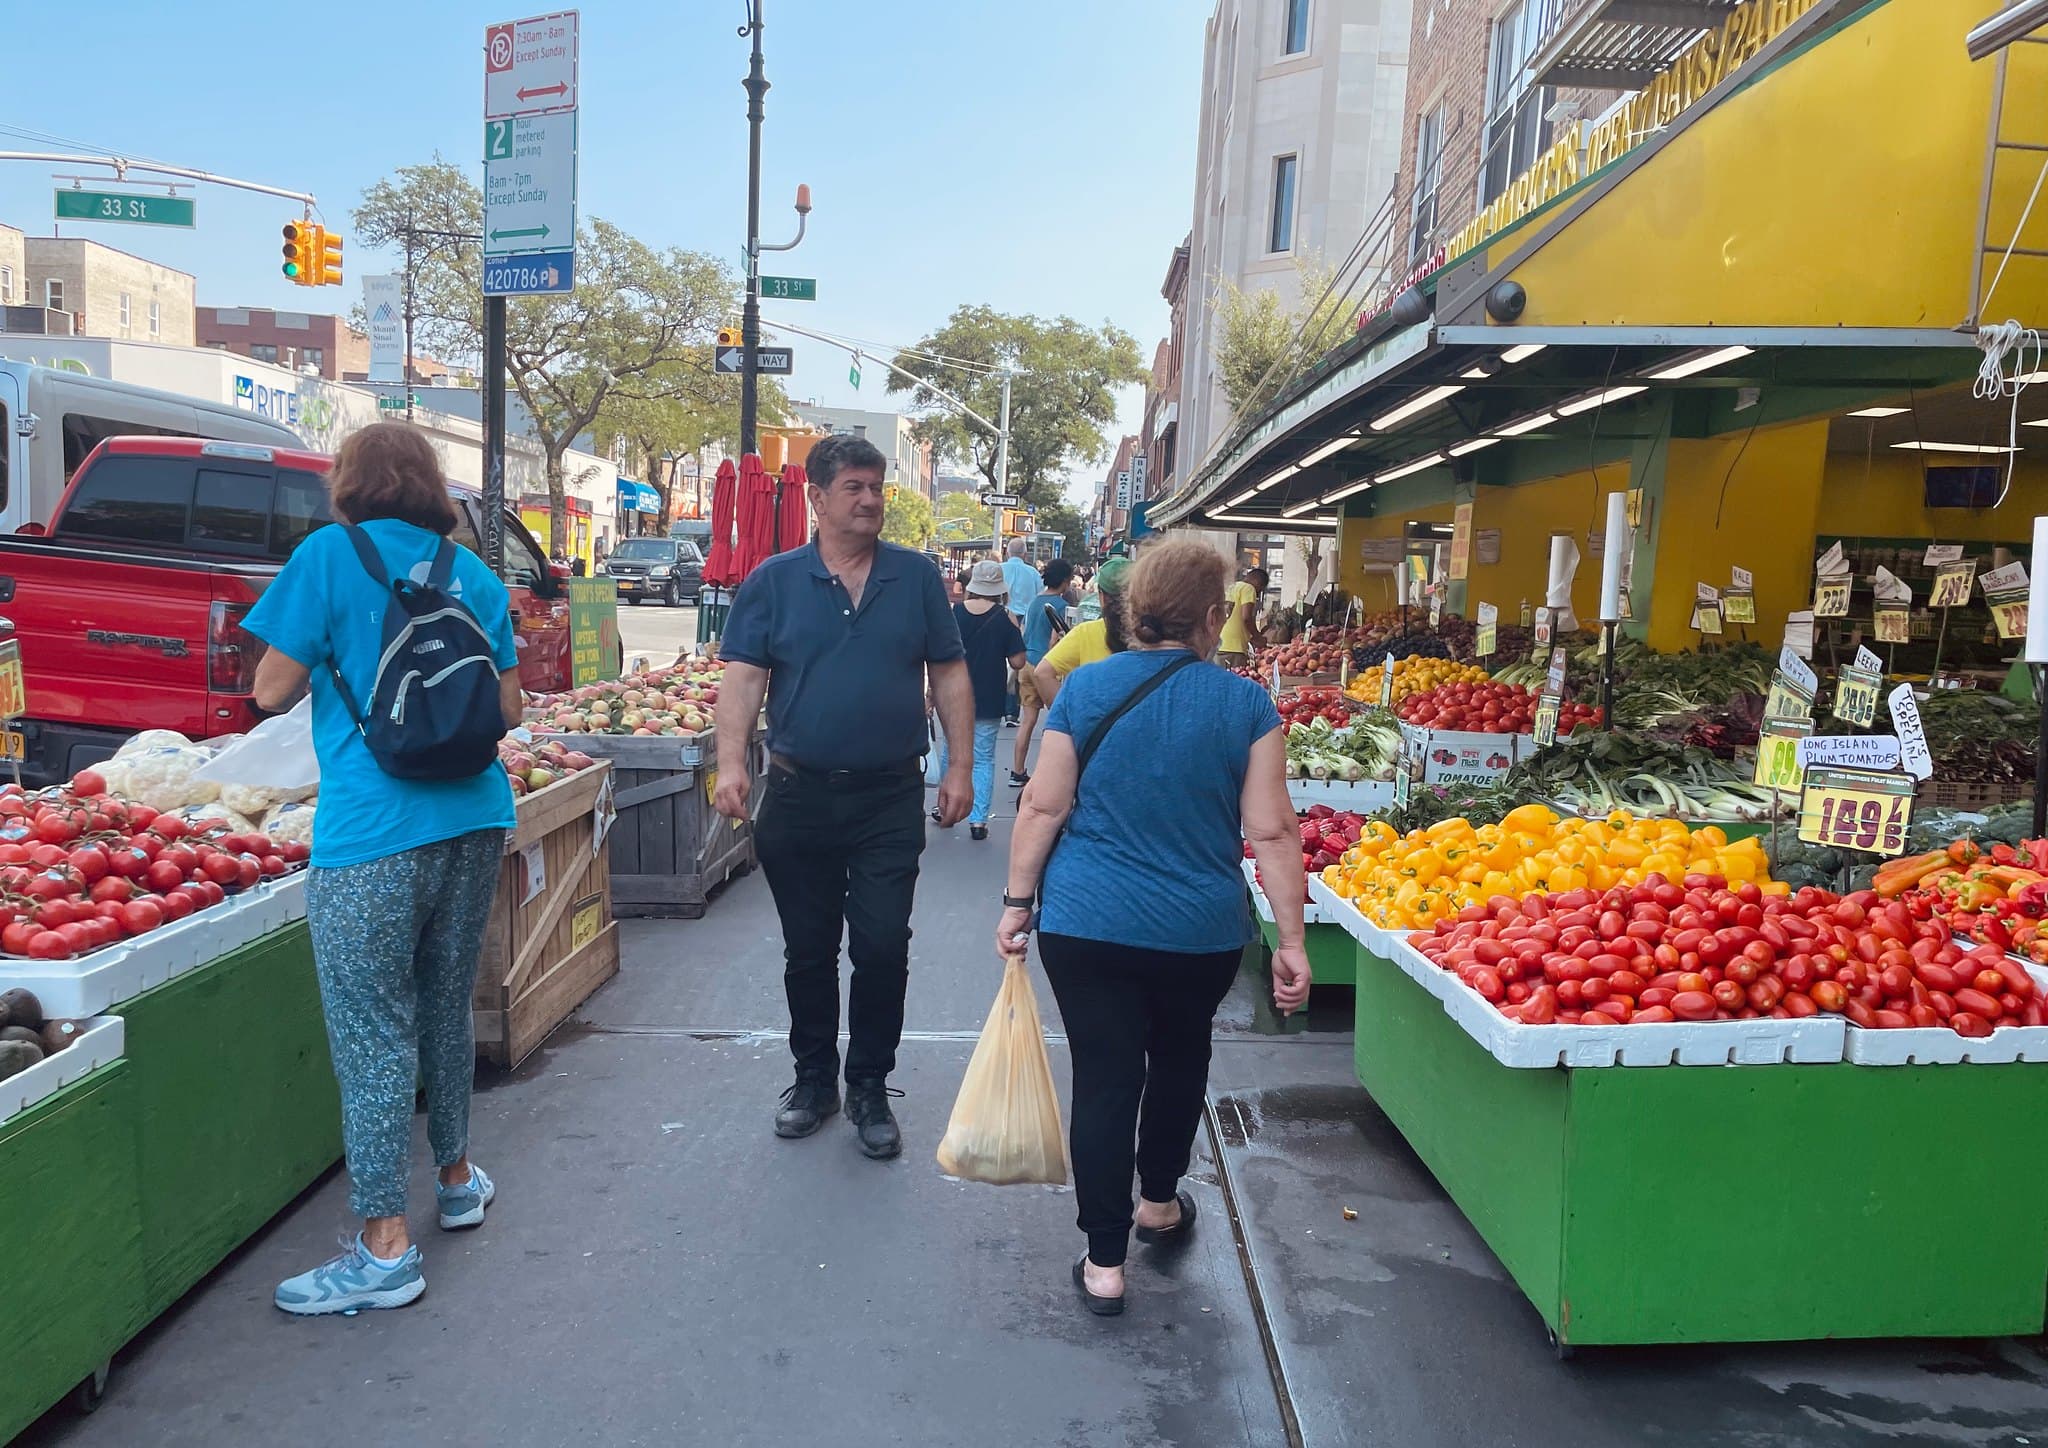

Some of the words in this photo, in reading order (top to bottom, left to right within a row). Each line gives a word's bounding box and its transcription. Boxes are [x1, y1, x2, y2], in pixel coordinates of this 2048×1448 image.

[549, 27, 565, 39] 8am
[516, 49, 540, 63] Except
[541, 45, 567, 60] Sunday
[493, 121, 506, 156] 2
[515, 131, 545, 143] metered
[1586, 95, 1638, 177] OPEN
[516, 146, 542, 159] parking
[489, 176, 507, 188] 8am
[514, 173, 532, 187] 7pm
[489, 191, 516, 206] Except
[518, 188, 548, 204] Sunday
[102, 198, 122, 217] 33
[129, 200, 147, 219] St
[486, 268, 538, 290] 420786
[773, 280, 789, 297] 33
[793, 280, 802, 292] St
[762, 355, 785, 366] WAY
[258, 384, 298, 424] RITE
[1733, 569, 1750, 585] KALE
[87, 630, 185, 650] RAPTOR
[1857, 650, 1879, 673] LEEKS
[1895, 701, 1919, 766] SPECIAL
[1803, 739, 1827, 750] LONG
[1832, 738, 1878, 750] ISLAND
[1806, 752, 1838, 764] PLUM
[1839, 753, 1898, 765] TOMATOES
[1437, 772, 1498, 786] TOMATOE
